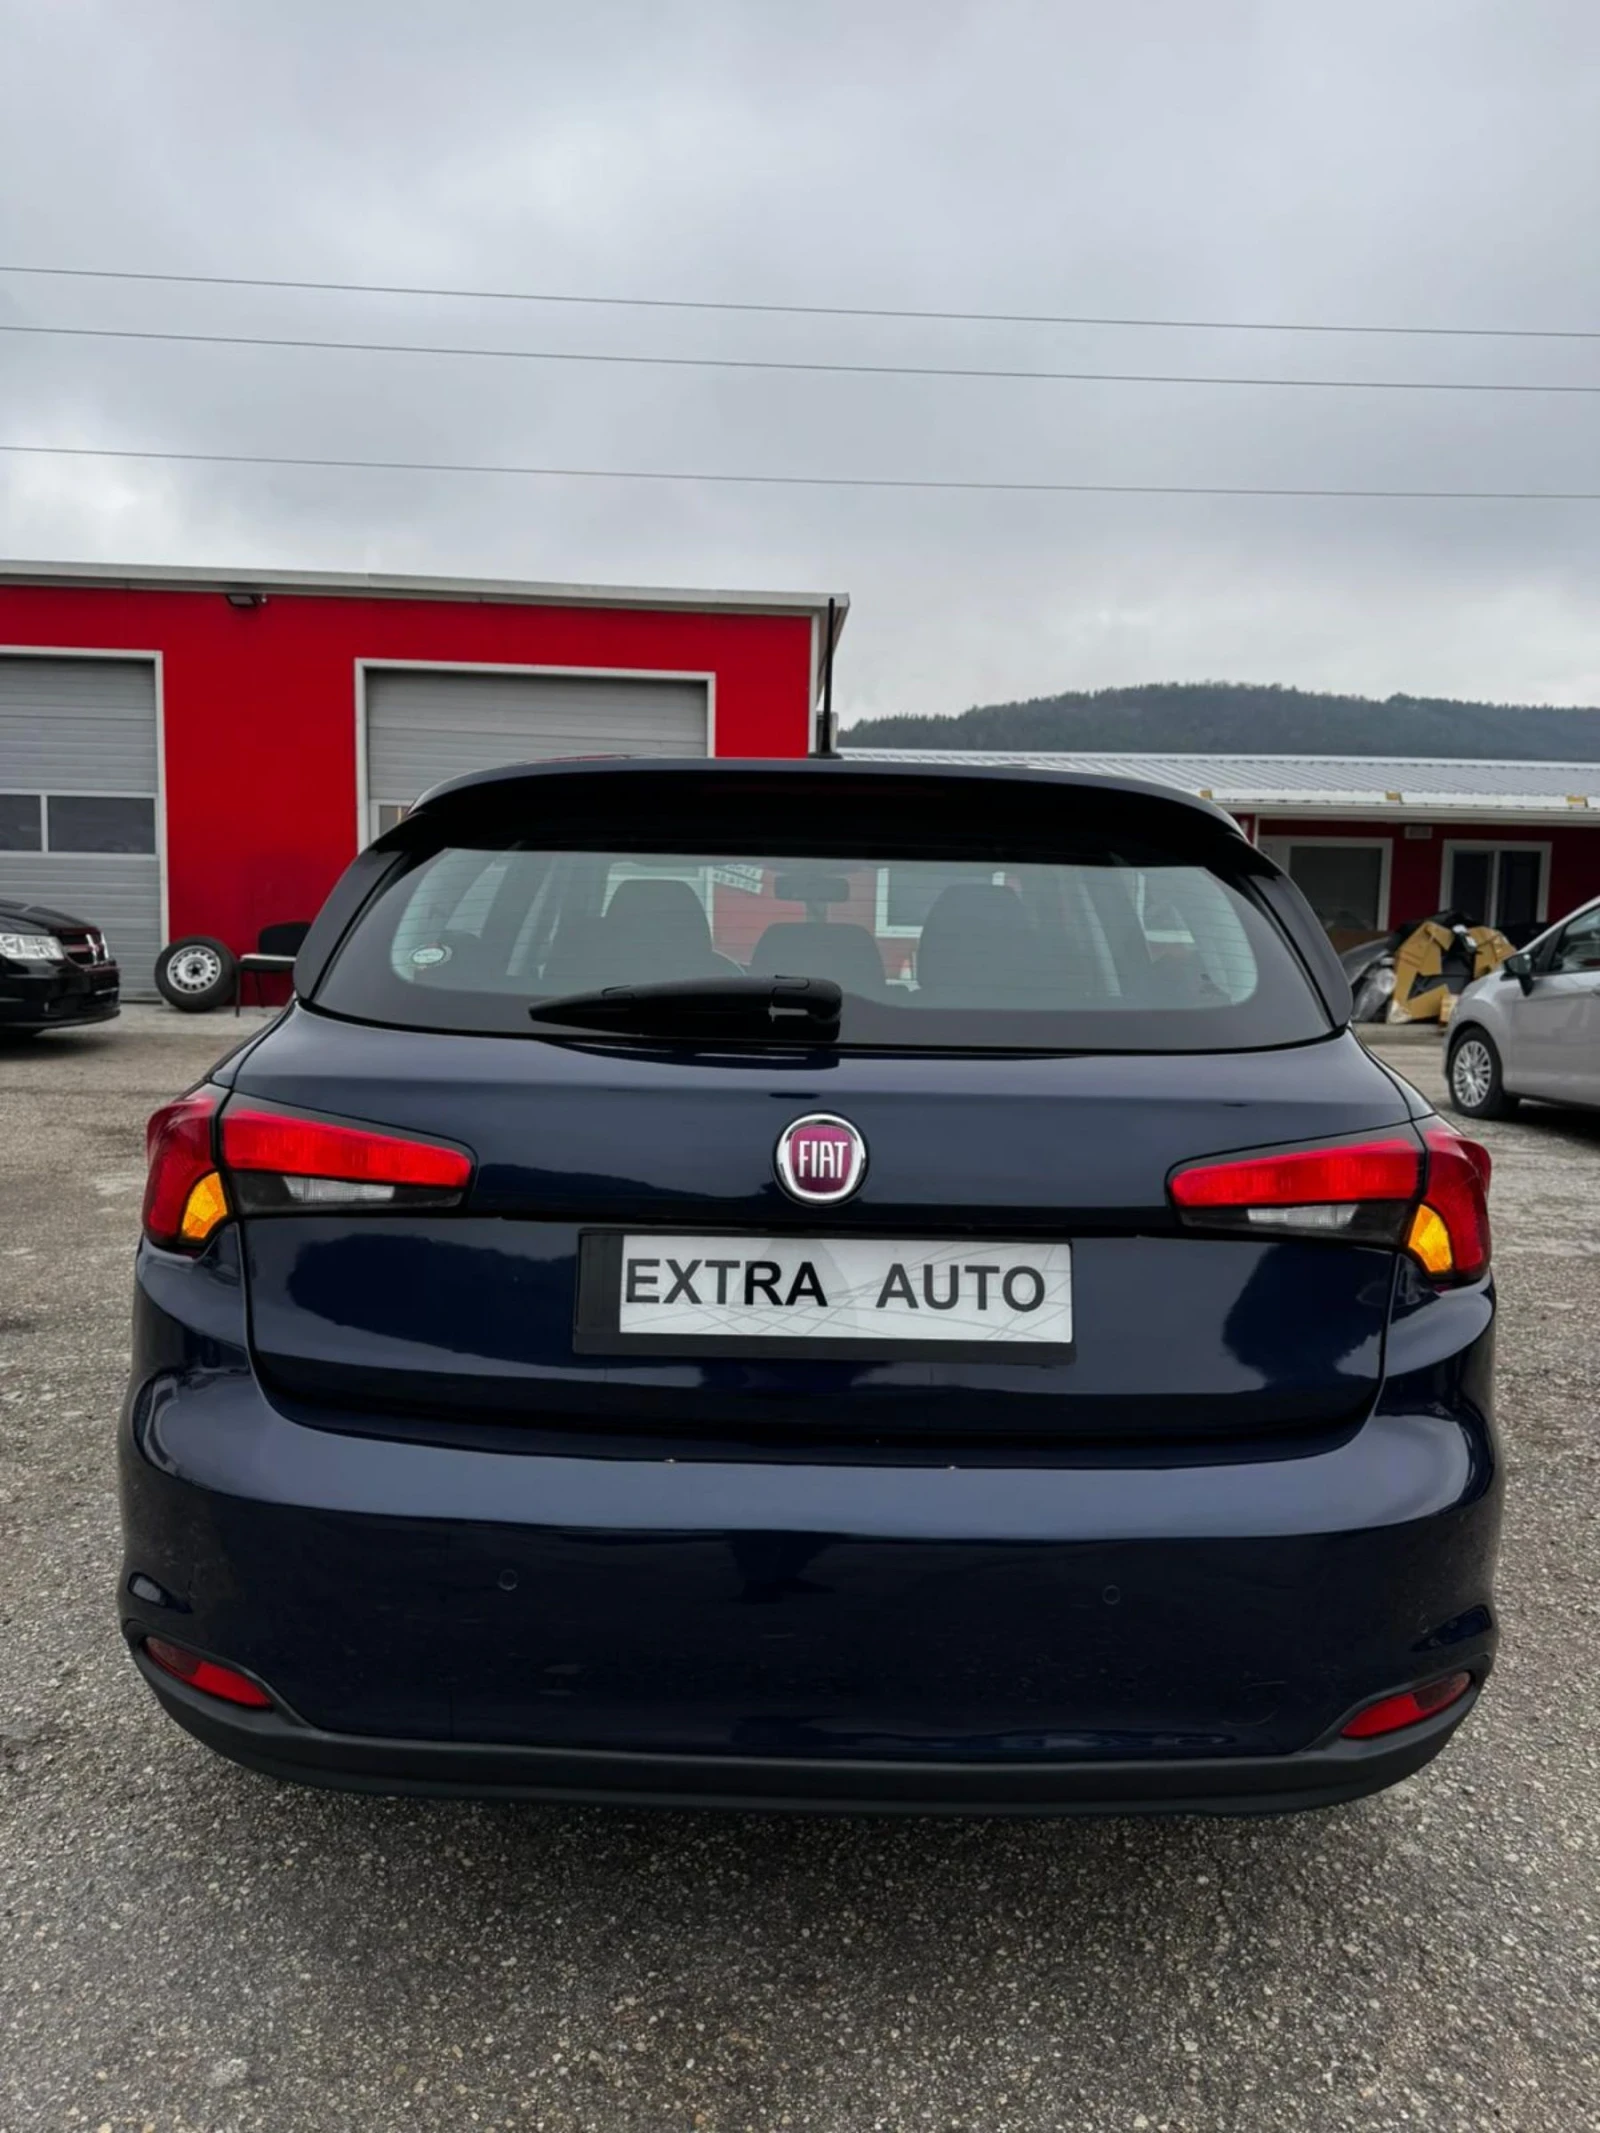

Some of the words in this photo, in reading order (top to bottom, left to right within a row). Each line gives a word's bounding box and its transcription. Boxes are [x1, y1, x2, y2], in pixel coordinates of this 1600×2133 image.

[798, 1140, 849, 1178] FIAT
[625, 1258, 828, 1307] EXTRA
[875, 1263, 1045, 1312] AUTO
